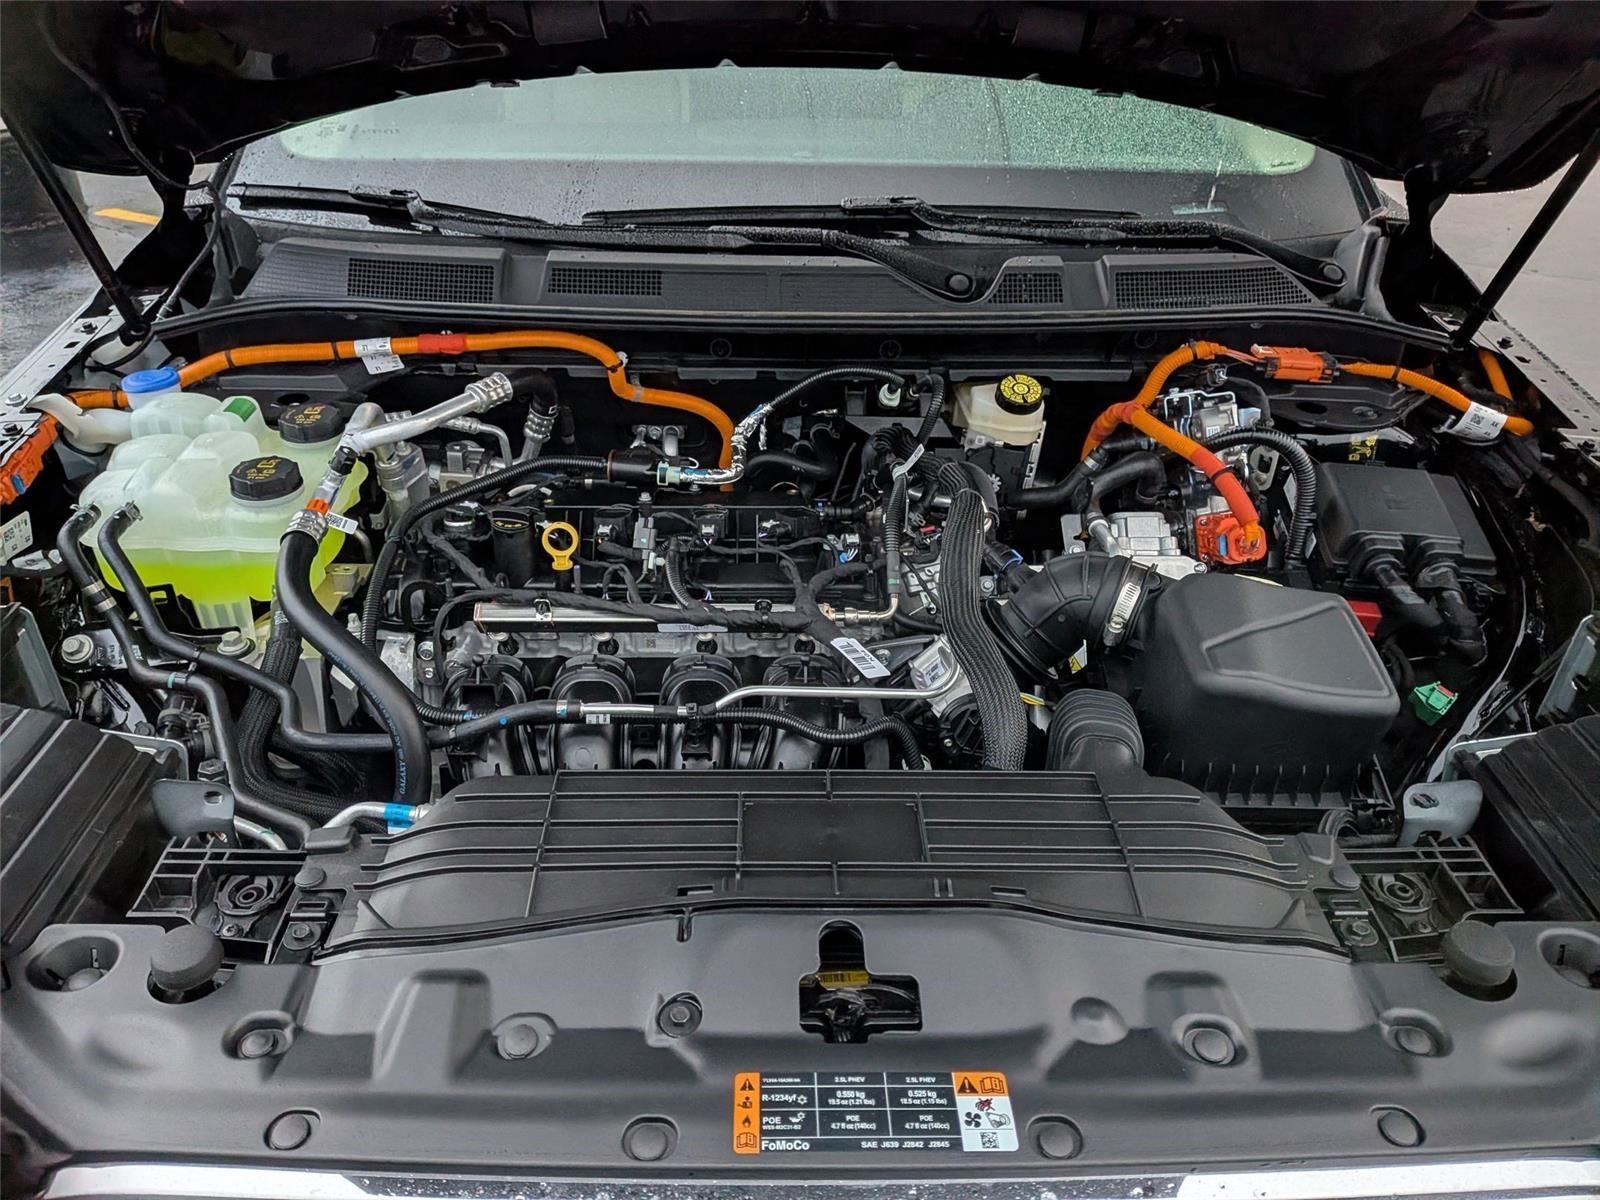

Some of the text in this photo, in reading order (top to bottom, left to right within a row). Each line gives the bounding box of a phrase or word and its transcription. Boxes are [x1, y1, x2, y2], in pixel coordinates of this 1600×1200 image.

[762, 1094, 797, 1103] R-1234yf
[856, 1090, 865, 1099] kg
[928, 1090, 936, 1098] kg
[762, 1116, 782, 1124] POE
[762, 1140, 810, 1150] FoMoCo
